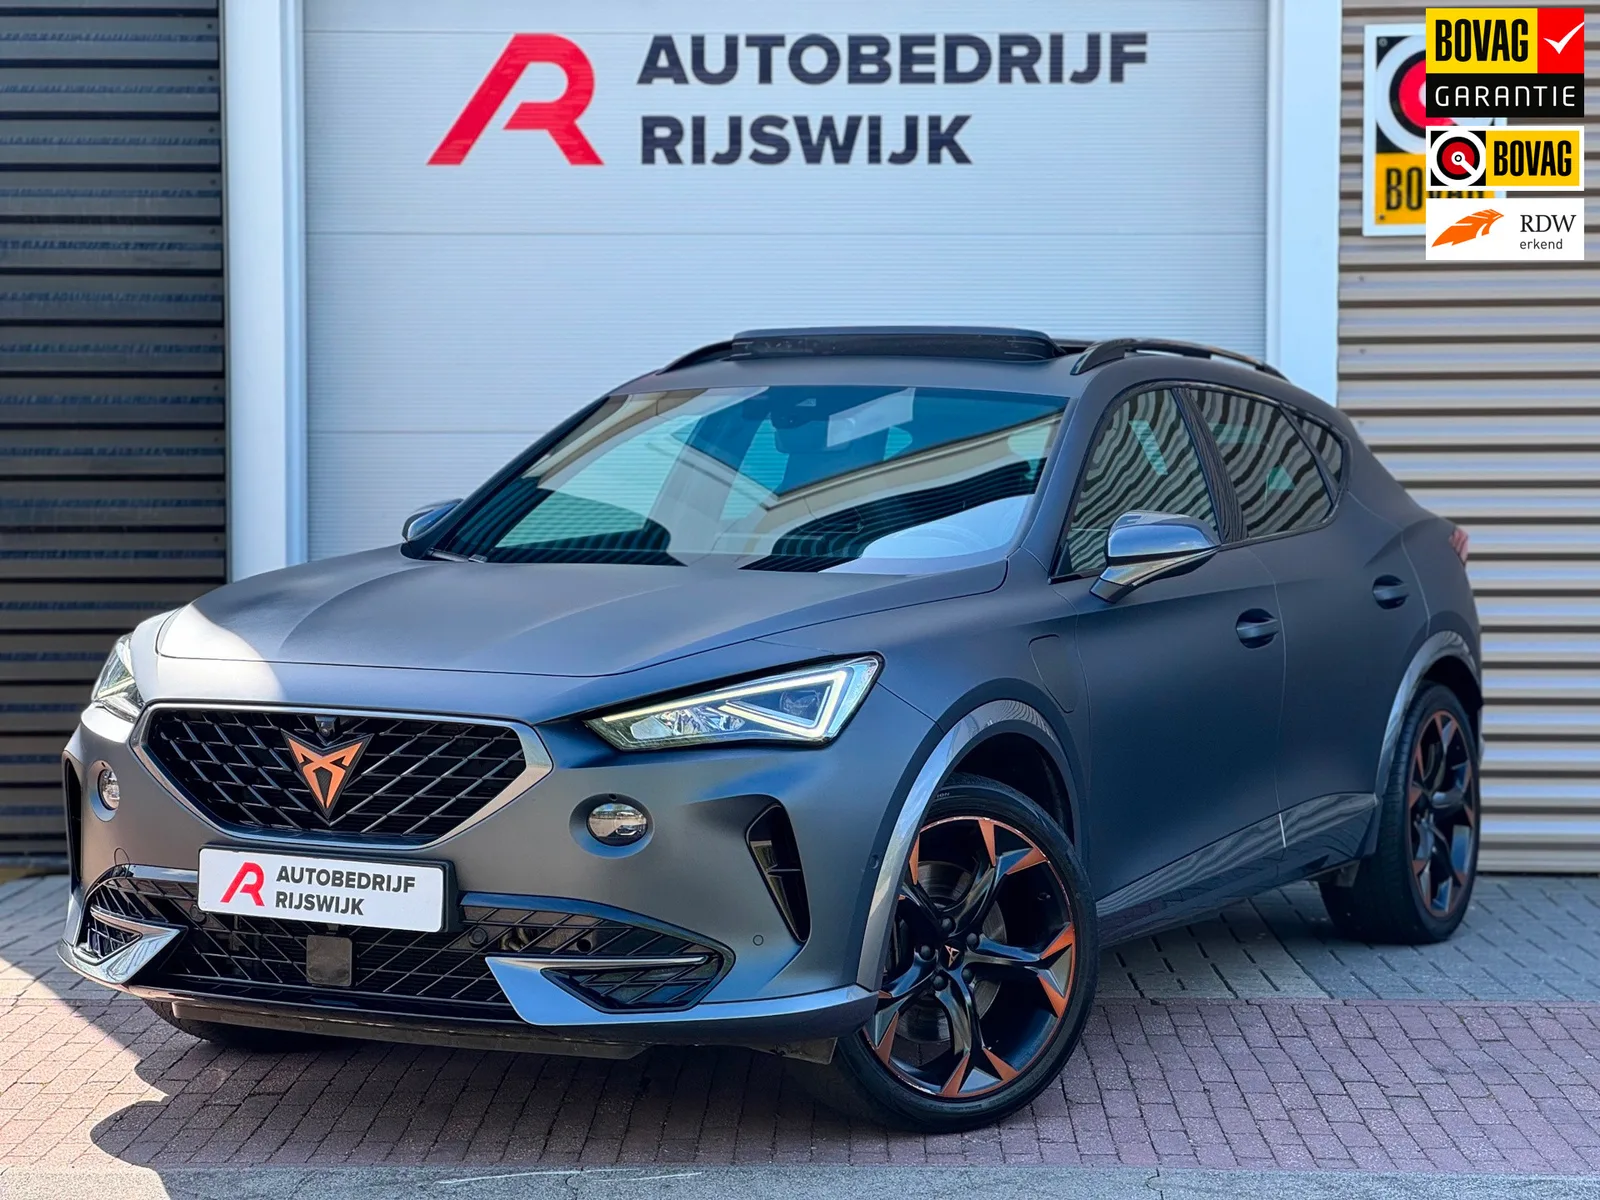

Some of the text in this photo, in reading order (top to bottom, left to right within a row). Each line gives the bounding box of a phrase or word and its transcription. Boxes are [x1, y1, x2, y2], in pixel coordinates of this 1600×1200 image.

[637, 33, 1148, 86] AUTOBEDRIJF
[641, 115, 972, 166] RIJSWIJK
[276, 866, 416, 893] AUTOBEDRIJF
[275, 891, 364, 916] RIJSWIJK
